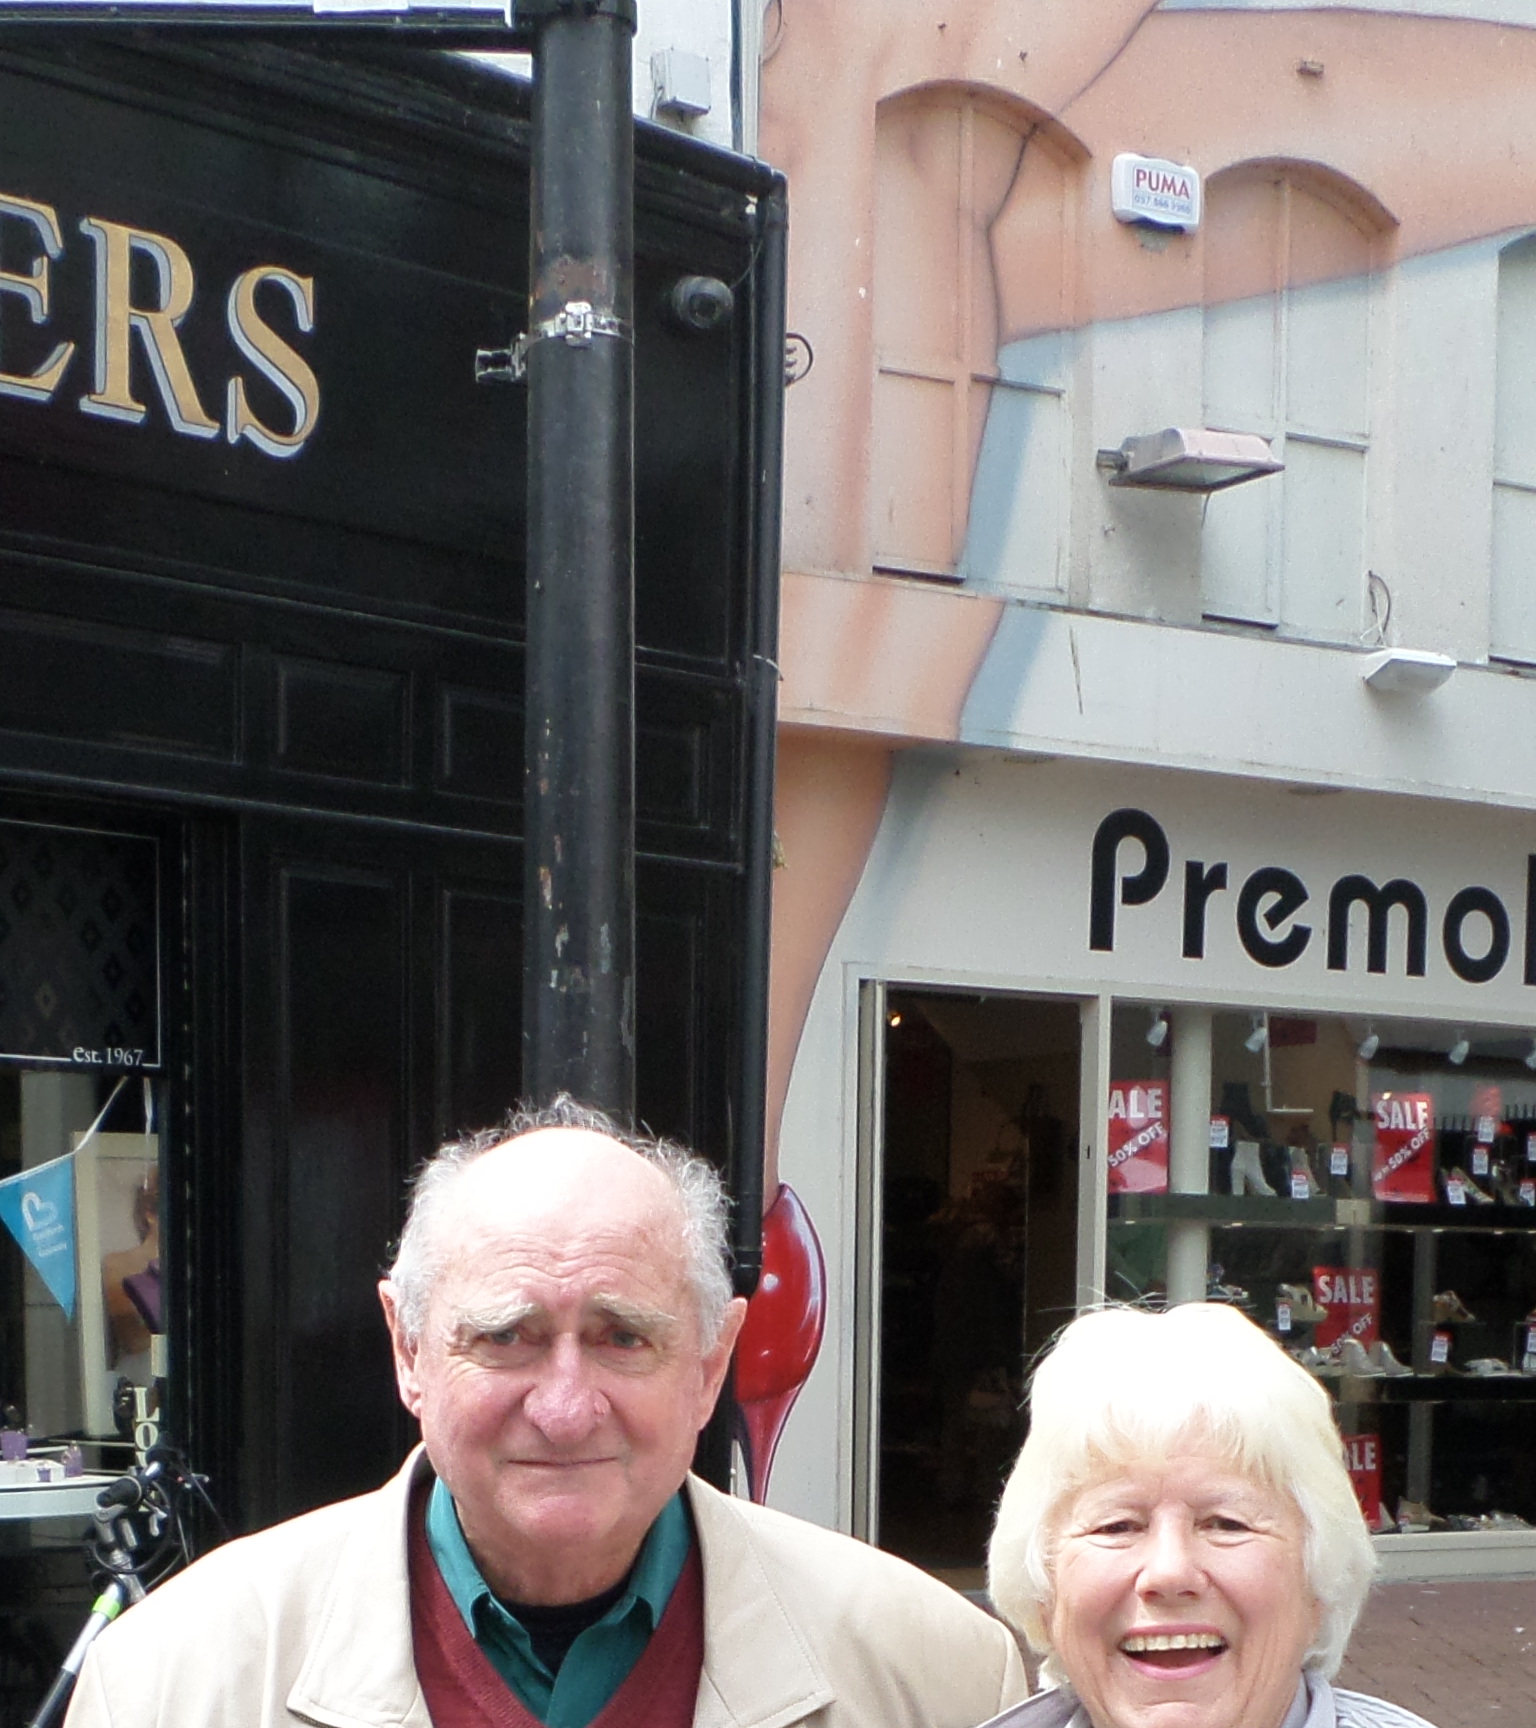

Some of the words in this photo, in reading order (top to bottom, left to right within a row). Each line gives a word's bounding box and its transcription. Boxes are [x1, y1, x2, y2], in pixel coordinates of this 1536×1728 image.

[1135, 168, 1190, 200] PUMA
[72, 1046, 103, 1064] est.
[106, 1047, 144, 1066] 1967
[1109, 1087, 1162, 1119] ALE
[1375, 1100, 1428, 1131] SALE
[1108, 1139, 1139, 1167] 50%
[1138, 1120, 1166, 1147] OFF
[1388, 1145, 1413, 1169] 50%
[1410, 1127, 1432, 1150] OFF
[1318, 1275, 1375, 1305] SALE
[1352, 1312, 1373, 1335] OFF
